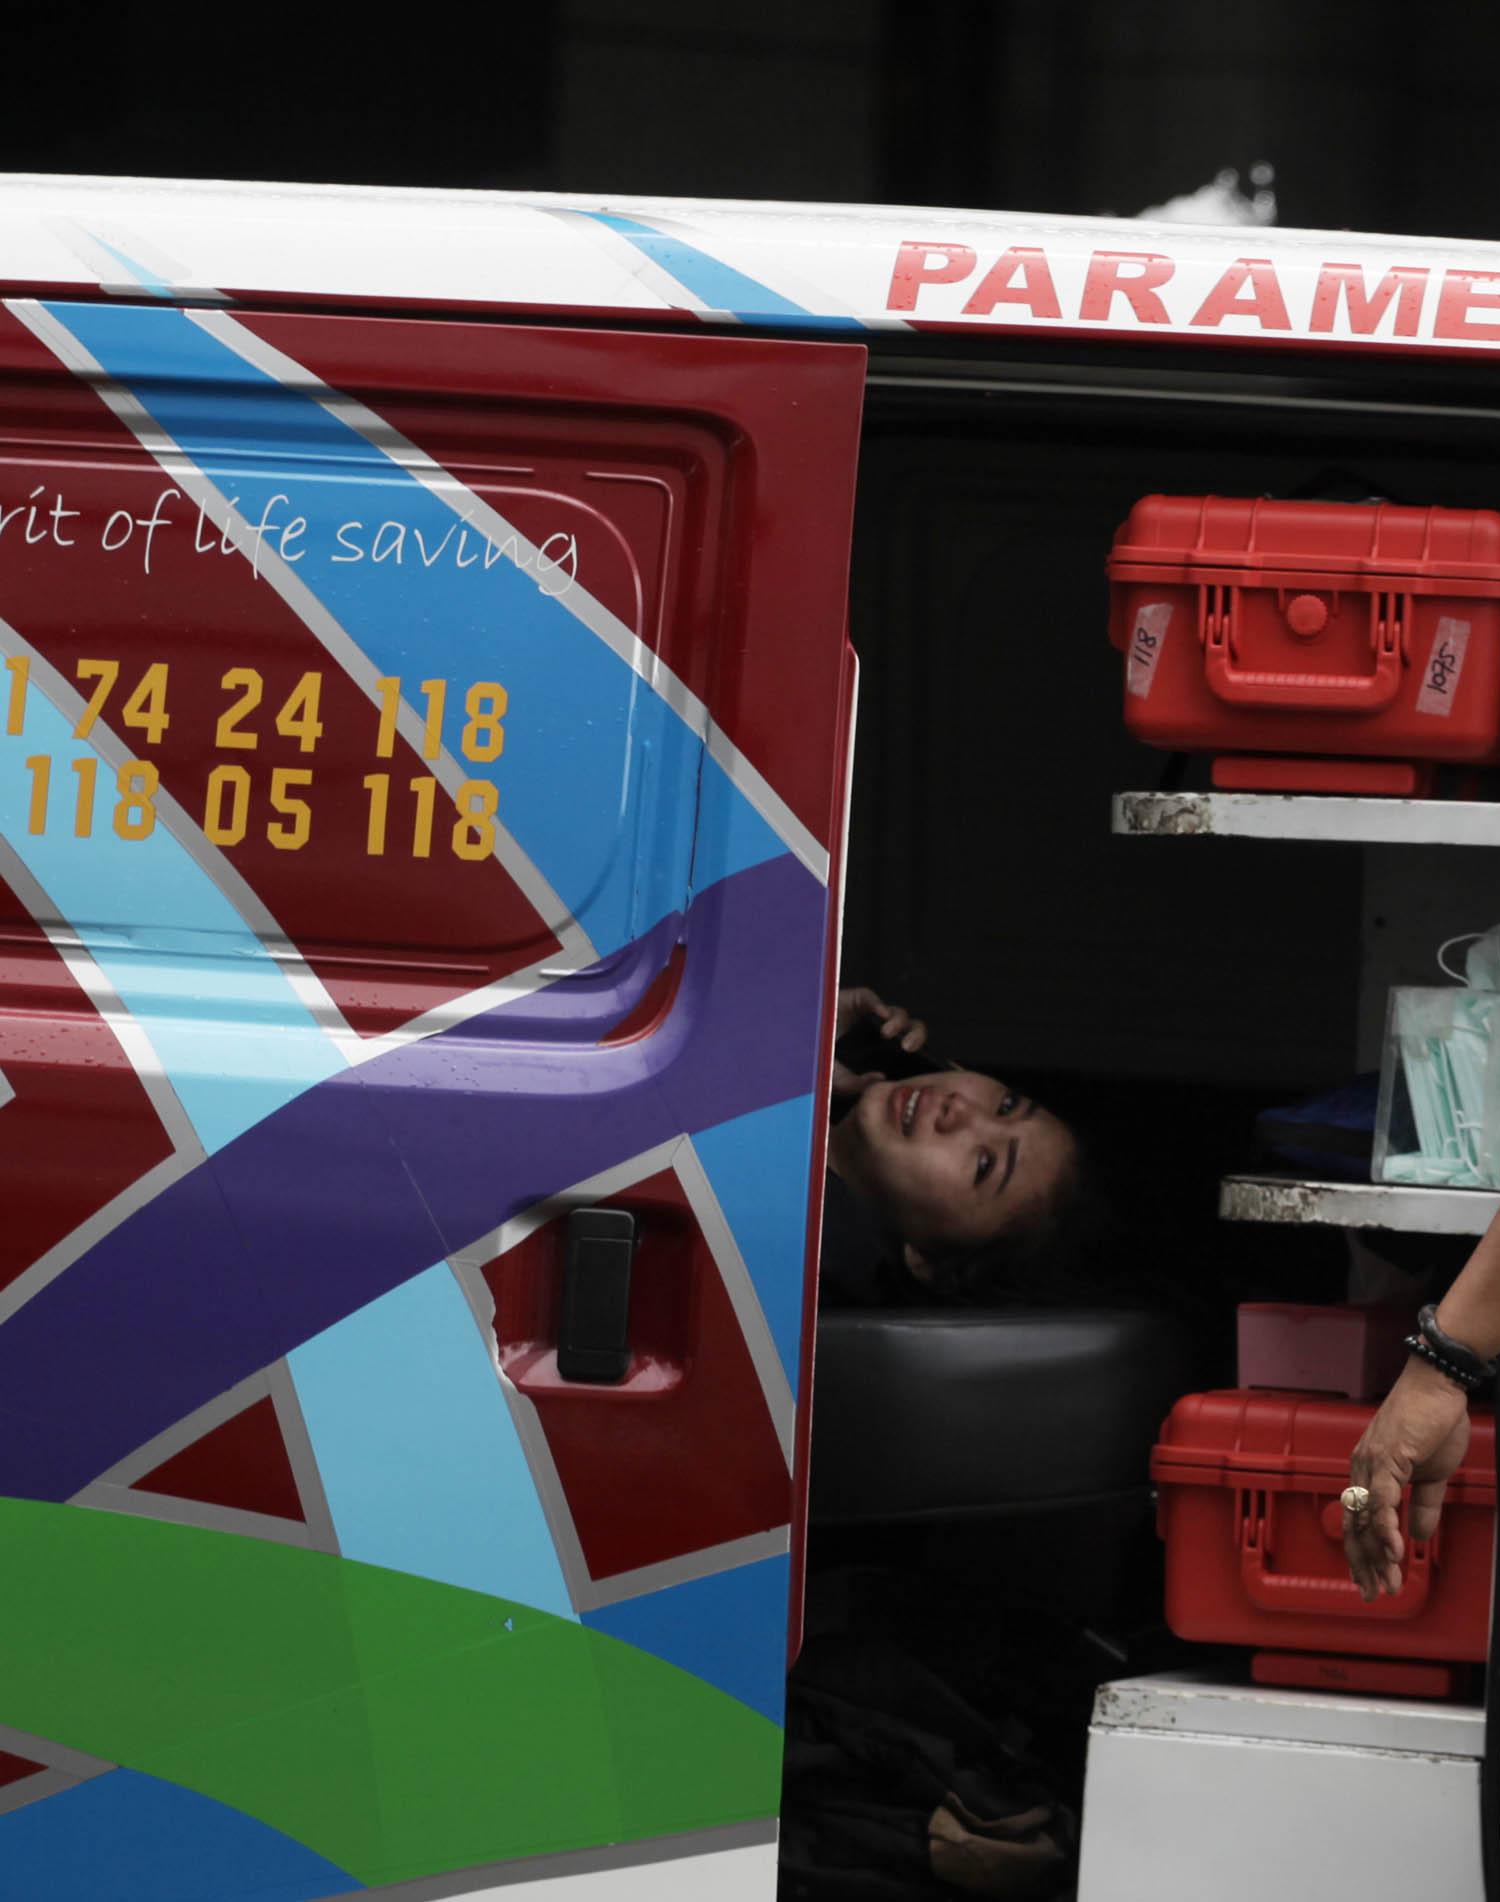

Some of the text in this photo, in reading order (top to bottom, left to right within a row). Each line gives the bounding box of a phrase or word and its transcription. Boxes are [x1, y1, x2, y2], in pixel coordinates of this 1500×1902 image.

[101, 488, 181, 574] of
[195, 492, 306, 579] life
[331, 508, 578, 596] saving
[5, 656, 509, 763] 1 74 24 118
[25, 755, 501, 862] 118 05 118
